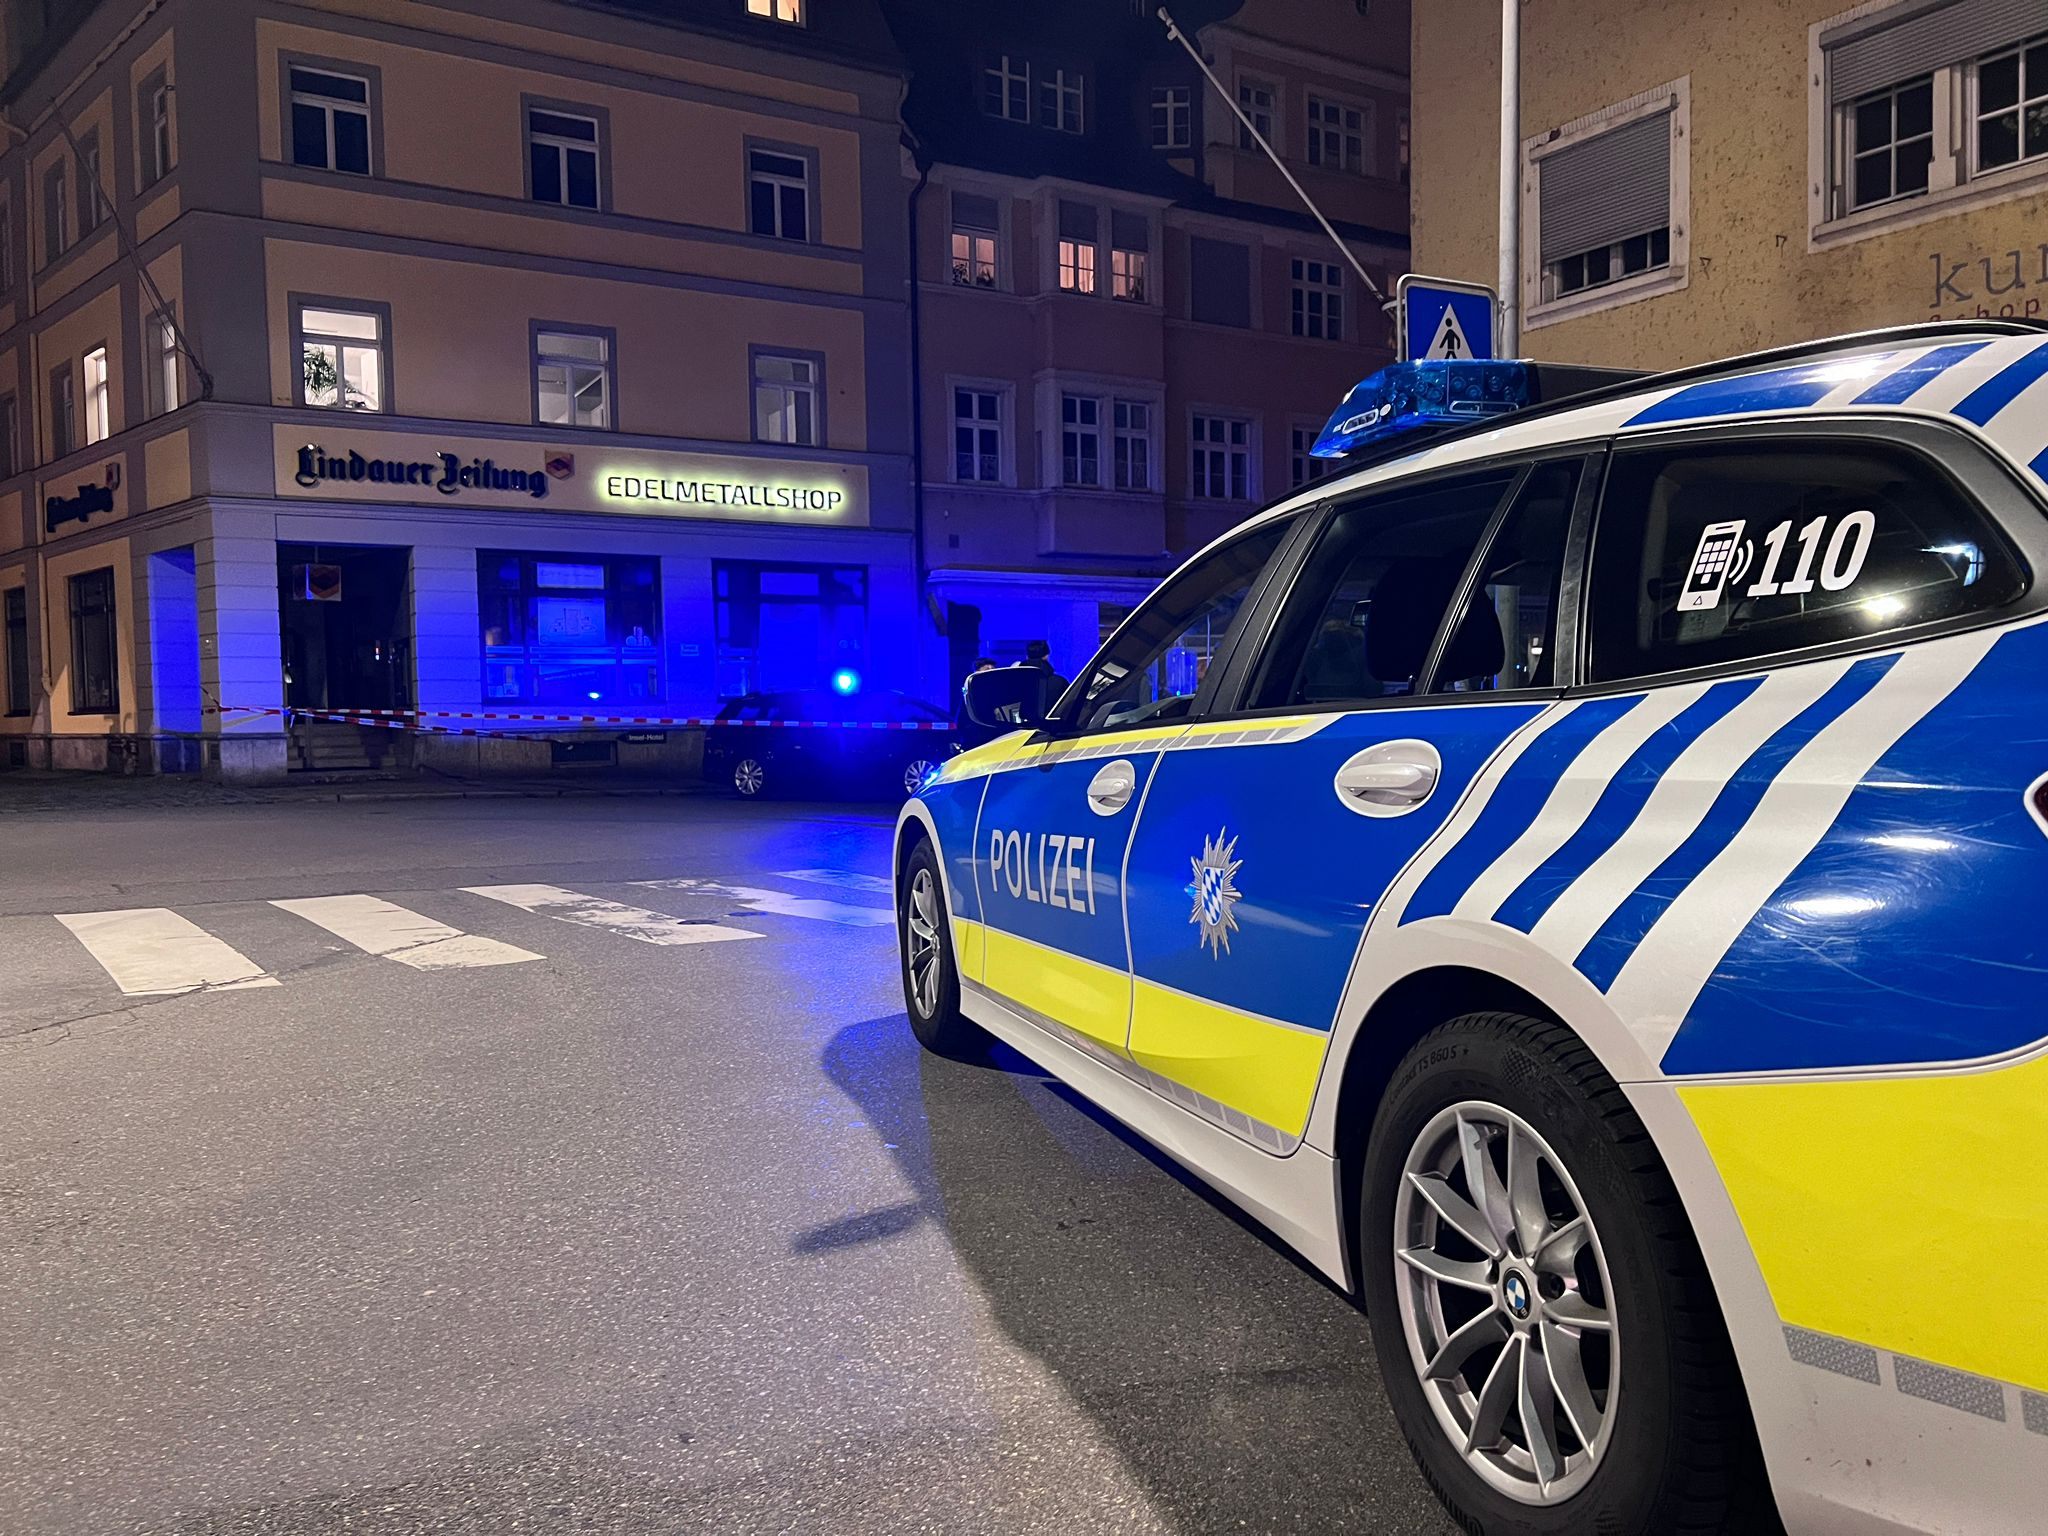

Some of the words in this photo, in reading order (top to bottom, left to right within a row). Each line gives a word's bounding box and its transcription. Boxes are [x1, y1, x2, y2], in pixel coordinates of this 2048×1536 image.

[295, 444, 435, 487] Lindauer
[436, 450, 548, 499] Zeitung
[607, 476, 842, 511] EDELMETALLSHOP
[1747, 510, 1875, 597] 110
[990, 829, 1095, 915] POLIZEI
